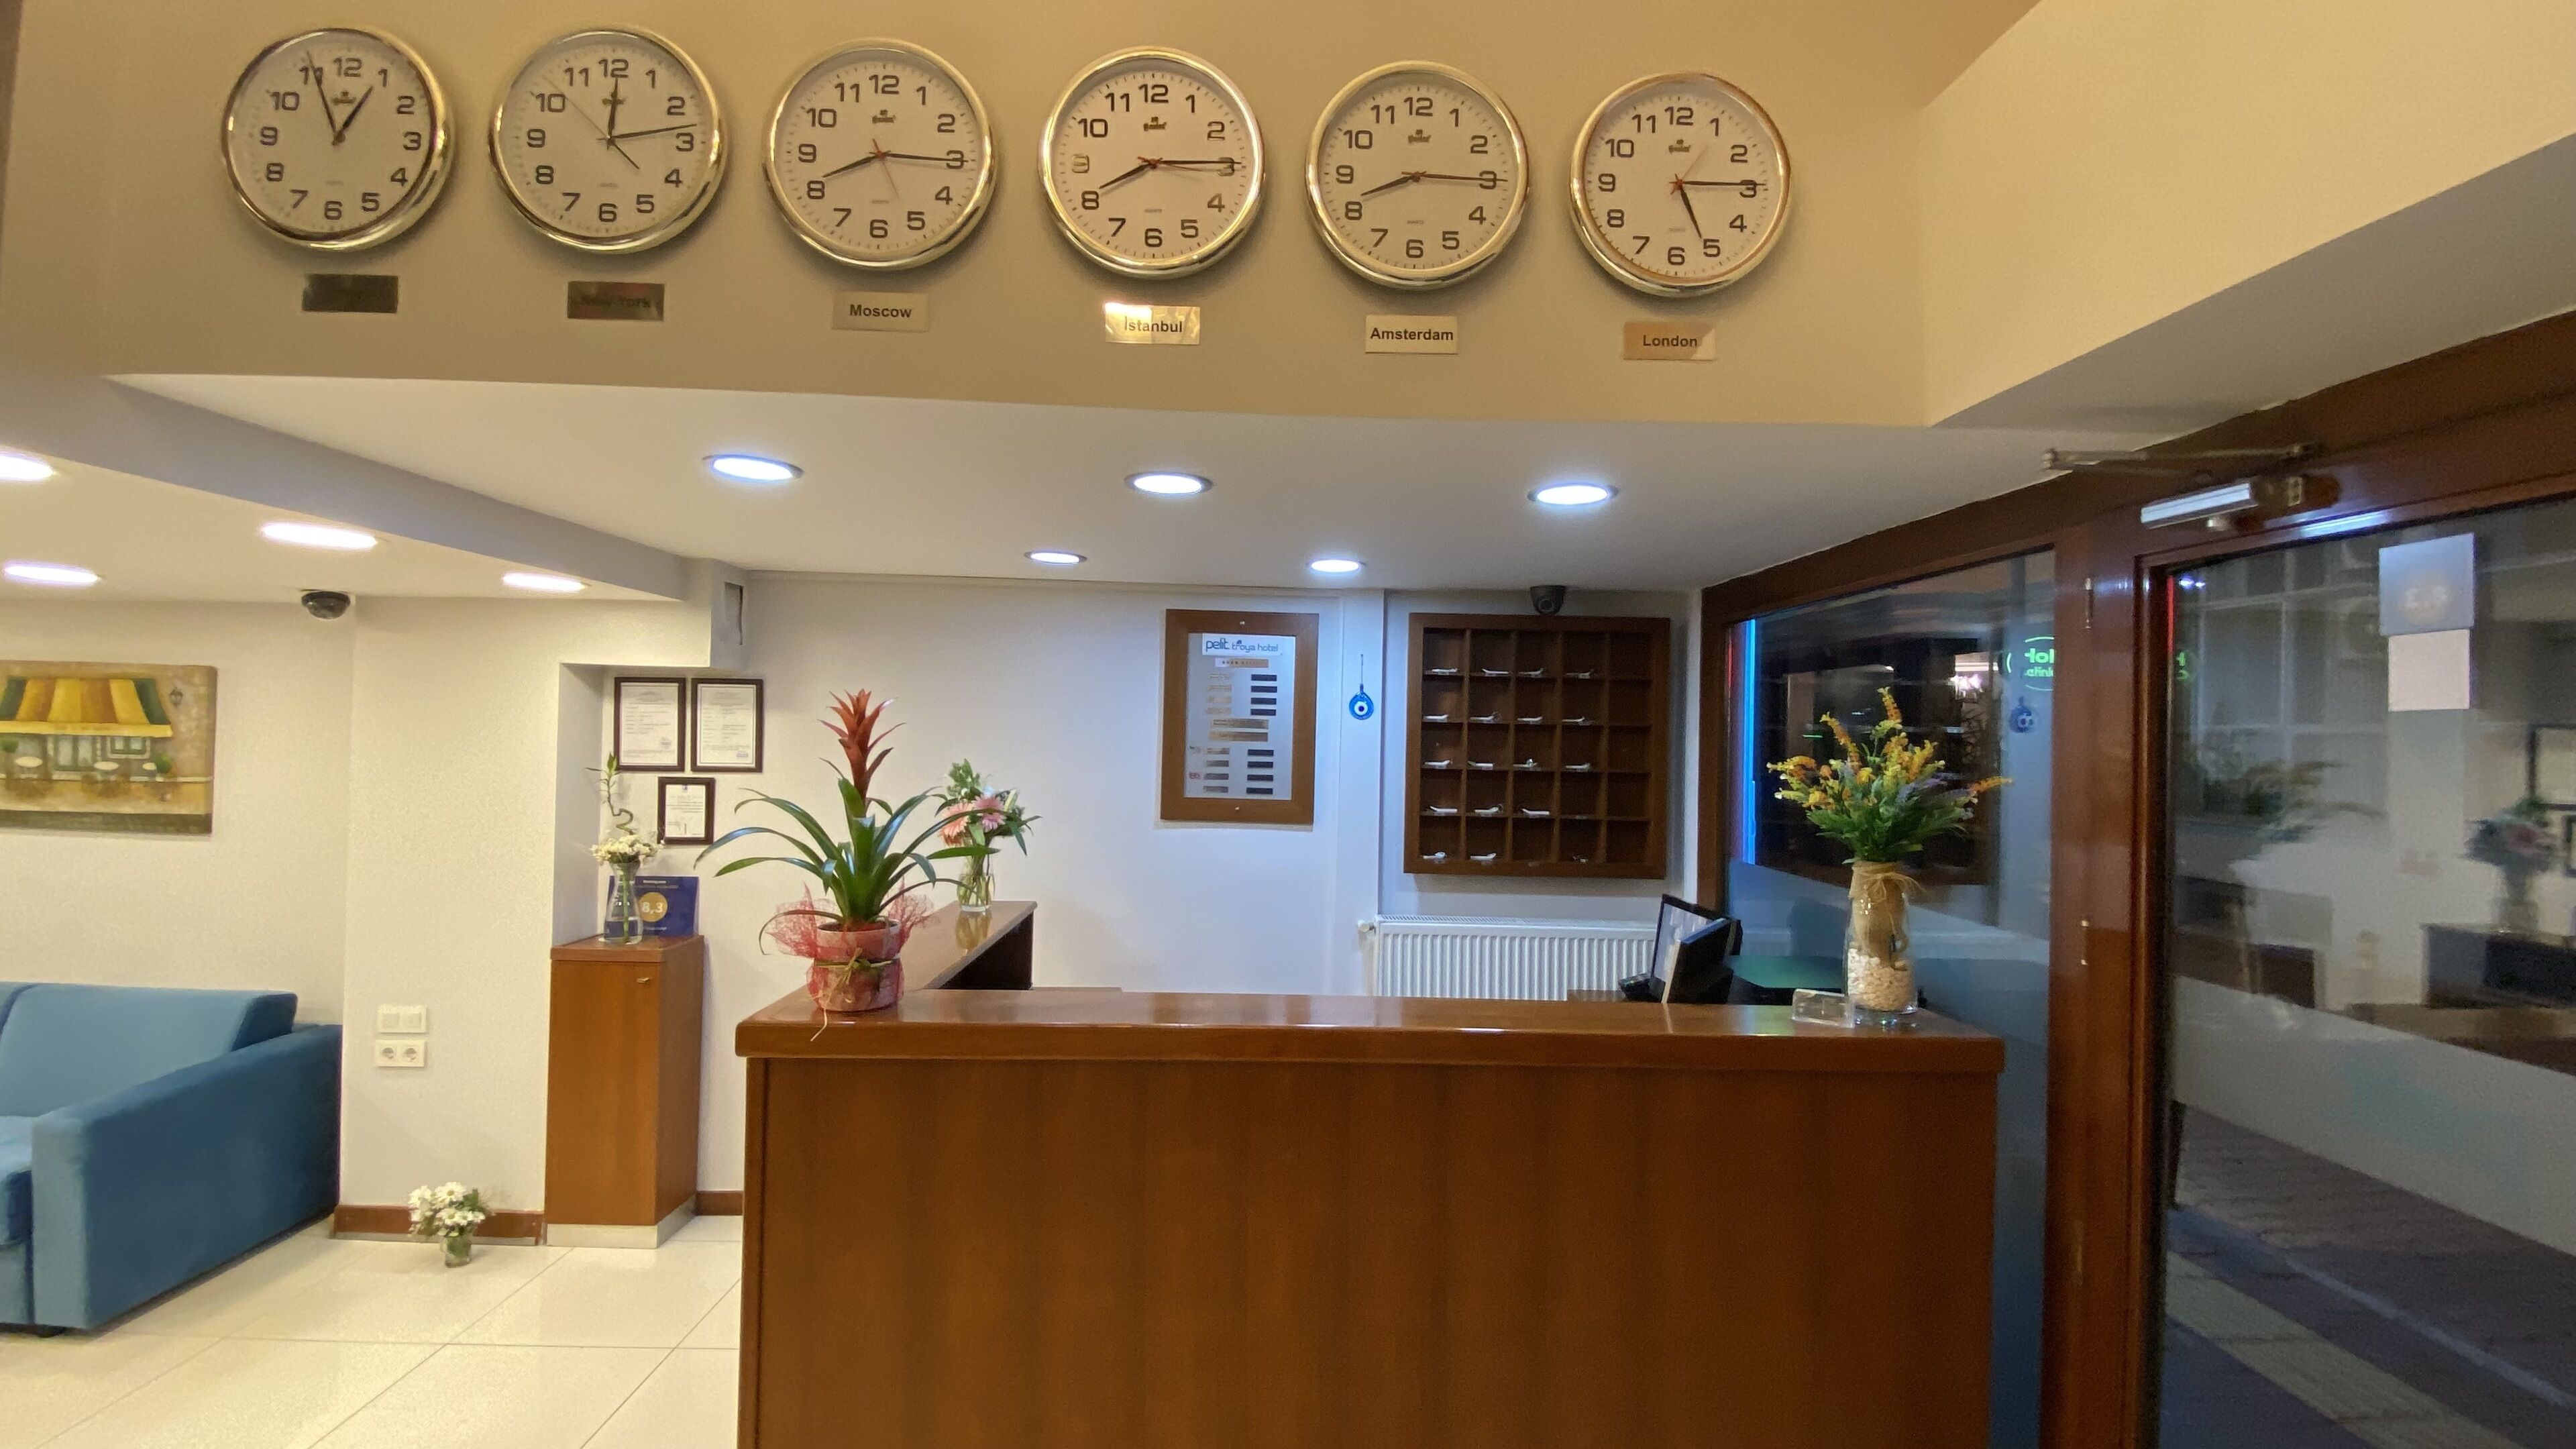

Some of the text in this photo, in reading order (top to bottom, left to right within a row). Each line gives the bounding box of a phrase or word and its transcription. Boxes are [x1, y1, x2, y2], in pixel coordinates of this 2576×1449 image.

[301, 67, 322, 84] 11
[333, 57, 362, 77] 12
[598, 59, 628, 77] 12
[378, 69, 388, 87] 1
[564, 68, 588, 87] 11
[646, 68, 655, 89] 1
[869, 74, 899, 95] 12
[270, 91, 299, 111] 10
[536, 93, 565, 112] 10
[835, 83, 859, 103] 11
[916, 87, 926, 105] 1
[1105, 93, 1130, 112] 11
[1139, 84, 1169, 103] 12
[396, 96, 415, 114] 2
[667, 97, 685, 115] 2
[1186, 95, 1195, 113] 1
[1404, 97, 1433, 116] 12
[806, 108, 837, 127] 10
[937, 114, 955, 133] 2
[1371, 105, 1395, 124] 11
[1450, 109, 1458, 127] 1
[1632, 114, 1656, 133] 11
[1664, 107, 1693, 125] 12
[260, 127, 278, 146] 9
[1078, 119, 1108, 138] 10
[1208, 121, 1225, 140] 2
[1710, 118, 1719, 136] 1
[403, 131, 421, 151] 3
[527, 129, 545, 148] 9
[676, 133, 694, 152] 3
[1343, 130, 1373, 150] 10
[1470, 136, 1488, 154] 2
[798, 144, 816, 163] 9
[1605, 139, 1634, 158] 10
[1731, 145, 1748, 163] 2
[947, 150, 964, 169] 3
[1072, 154, 1089, 172] 9
[1218, 158, 1234, 176] 3
[266, 163, 284, 182] 8
[390, 168, 408, 186] 4
[536, 165, 553, 184] 8
[664, 169, 682, 188] 4
[1336, 165, 1354, 184] 9
[1479, 171, 1497, 189] 3
[807, 180, 824, 199] 8
[1599, 174, 1615, 192] 9
[1739, 180, 1757, 198] 3
[290, 189, 308, 209] 7
[362, 193, 379, 212] 5
[562, 193, 580, 211] 7
[636, 195, 654, 213] 5
[935, 186, 953, 205] 4
[1081, 191, 1099, 209] 8
[1208, 194, 1225, 212] 4
[324, 201, 342, 220] 6
[598, 203, 616, 222] 6
[834, 208, 851, 227] 7
[1344, 201, 1362, 219] 8
[1468, 206, 1486, 225] 4
[1607, 209, 1624, 227] 8
[869, 219, 888, 238] 6
[907, 211, 925, 230] 5
[1109, 218, 1126, 237] 7
[1181, 219, 1198, 238] 5
[1729, 215, 1747, 232] 4
[1145, 228, 1163, 247] 6
[1371, 229, 1388, 247] 7
[1442, 231, 1459, 250] 5
[1633, 236, 1650, 254] 7
[1406, 239, 1424, 258] 6
[1668, 247, 1684, 265] 6
[1703, 239, 1720, 257] 5
[849, 304, 912, 318] Moscow
[1370, 327, 1454, 341] Amsterdam
[1643, 335, 1697, 347] London
[1205, 638, 1278, 653] pelit troya hotel
